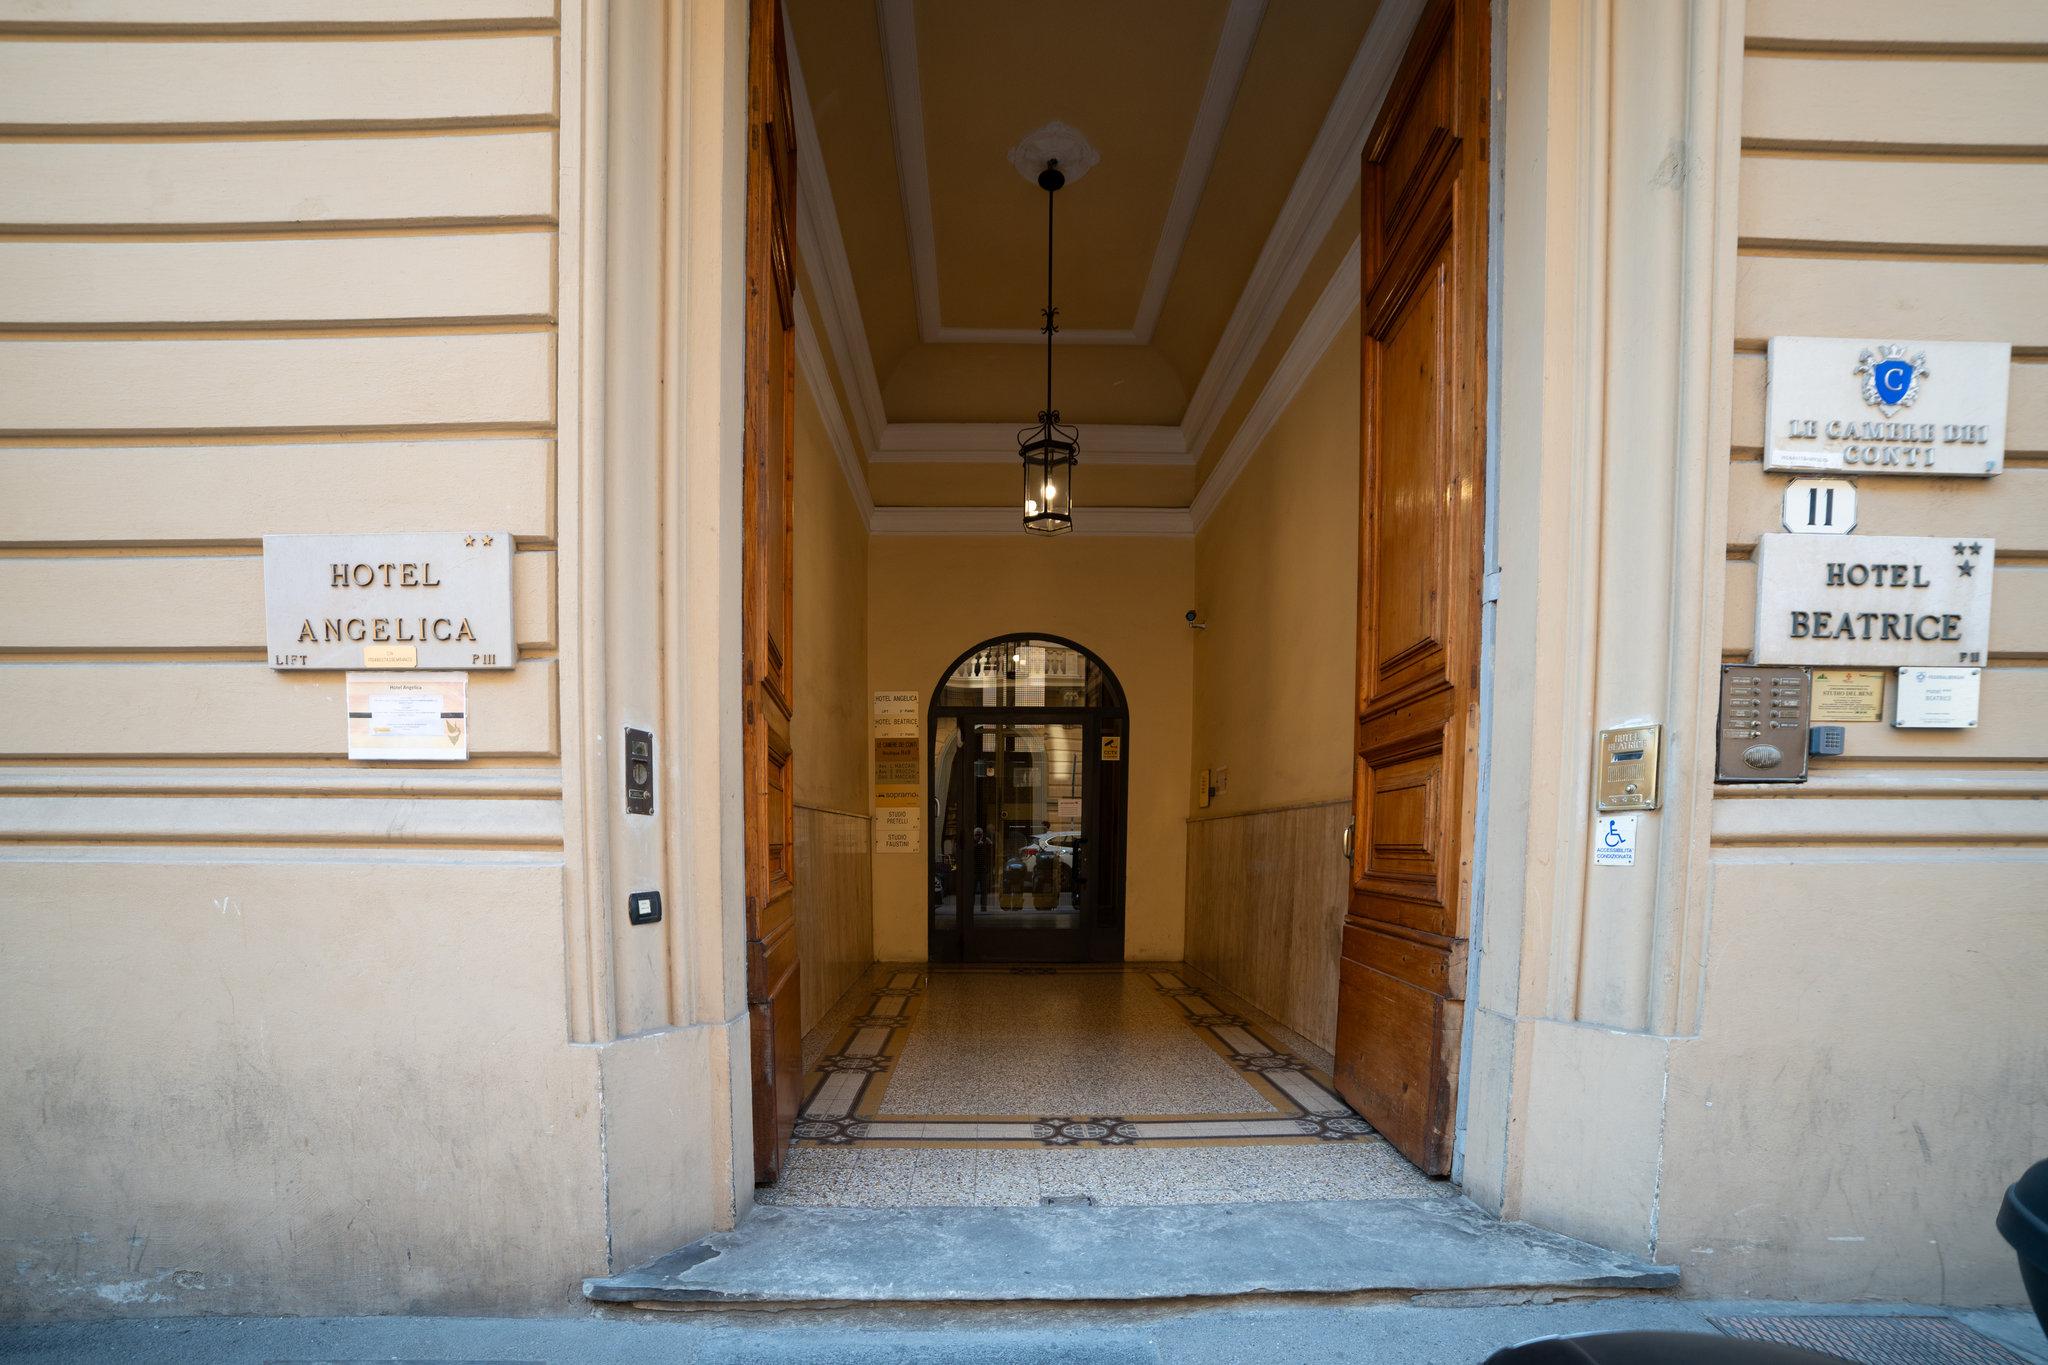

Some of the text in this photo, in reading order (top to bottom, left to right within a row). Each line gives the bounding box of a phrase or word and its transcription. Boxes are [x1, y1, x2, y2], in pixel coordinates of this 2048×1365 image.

[1884, 367, 1904, 392] C
[1788, 418, 1990, 445] LE CAMERE DEI
[1843, 444, 1935, 467] CONTI
[1807, 488, 1834, 526] 11
[330, 562, 441, 588] HOTEL
[1826, 562, 1931, 588] HOTEL
[297, 617, 477, 643] ANGELICA
[1789, 610, 1963, 642] BEATRICE
[275, 654, 308, 666] LIFT
